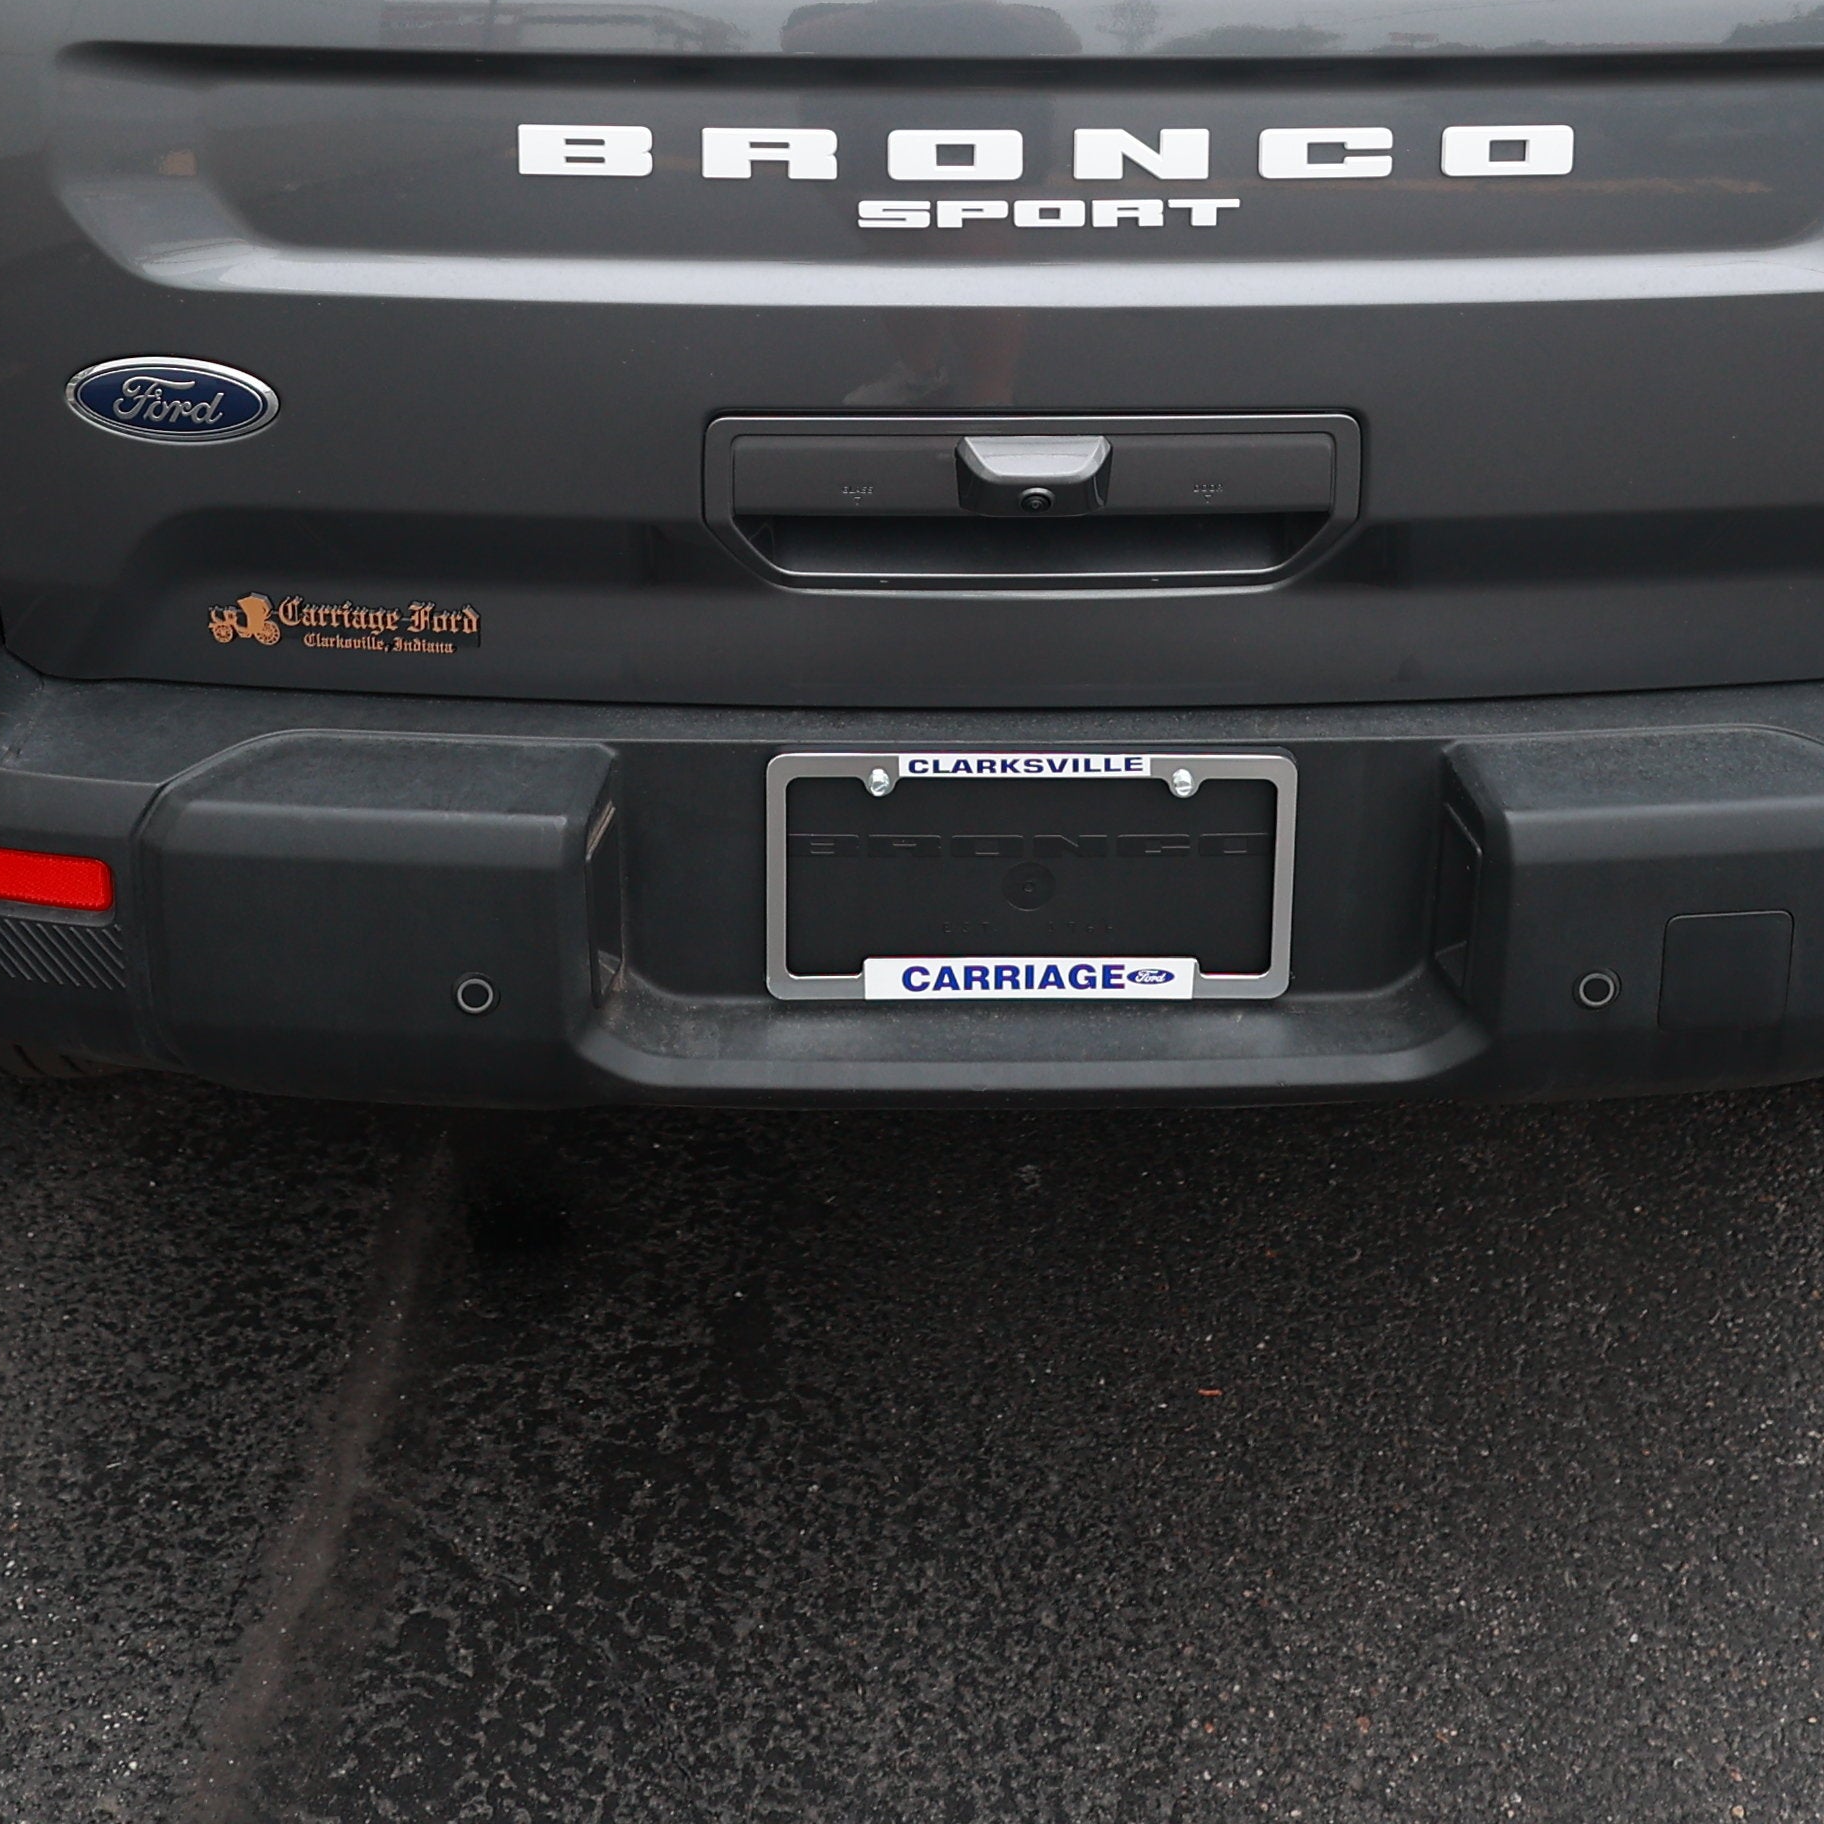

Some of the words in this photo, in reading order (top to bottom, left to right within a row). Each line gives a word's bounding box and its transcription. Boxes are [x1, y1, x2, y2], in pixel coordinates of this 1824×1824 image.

[517, 123, 1575, 182] BRONCO
[856, 198, 1241, 230] SPORT
[112, 375, 226, 425] Ford
[278, 595, 402, 636] Carriage
[407, 600, 481, 635] Ford
[391, 636, 457, 654] Indiana
[907, 756, 1145, 775] CLARKSVILLE
[901, 963, 1126, 993] CARRIAGE
